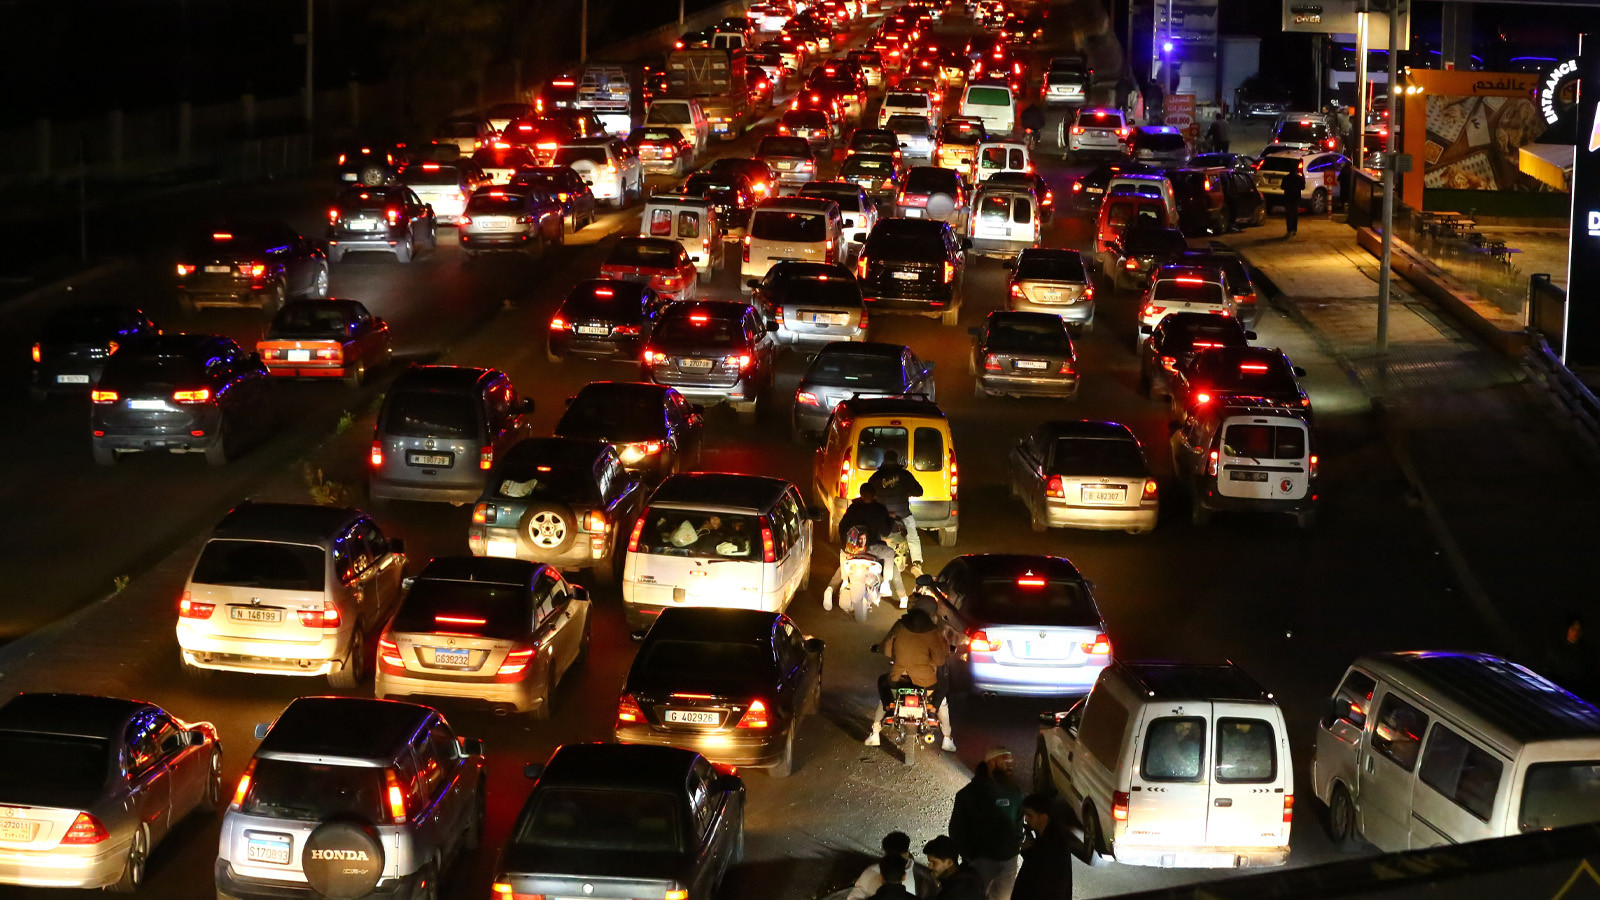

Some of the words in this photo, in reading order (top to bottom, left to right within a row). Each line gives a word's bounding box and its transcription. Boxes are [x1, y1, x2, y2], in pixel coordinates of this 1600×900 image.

[1541, 59, 1578, 125] ENTRANCE
[237, 610, 243, 618] N
[248, 611, 275, 620] 146199
[435, 654, 468, 665] G639232
[671, 712, 677, 721] G
[682, 712, 713, 723] 402926
[249, 846, 289, 861] S170893
[311, 849, 370, 861] HONDA
